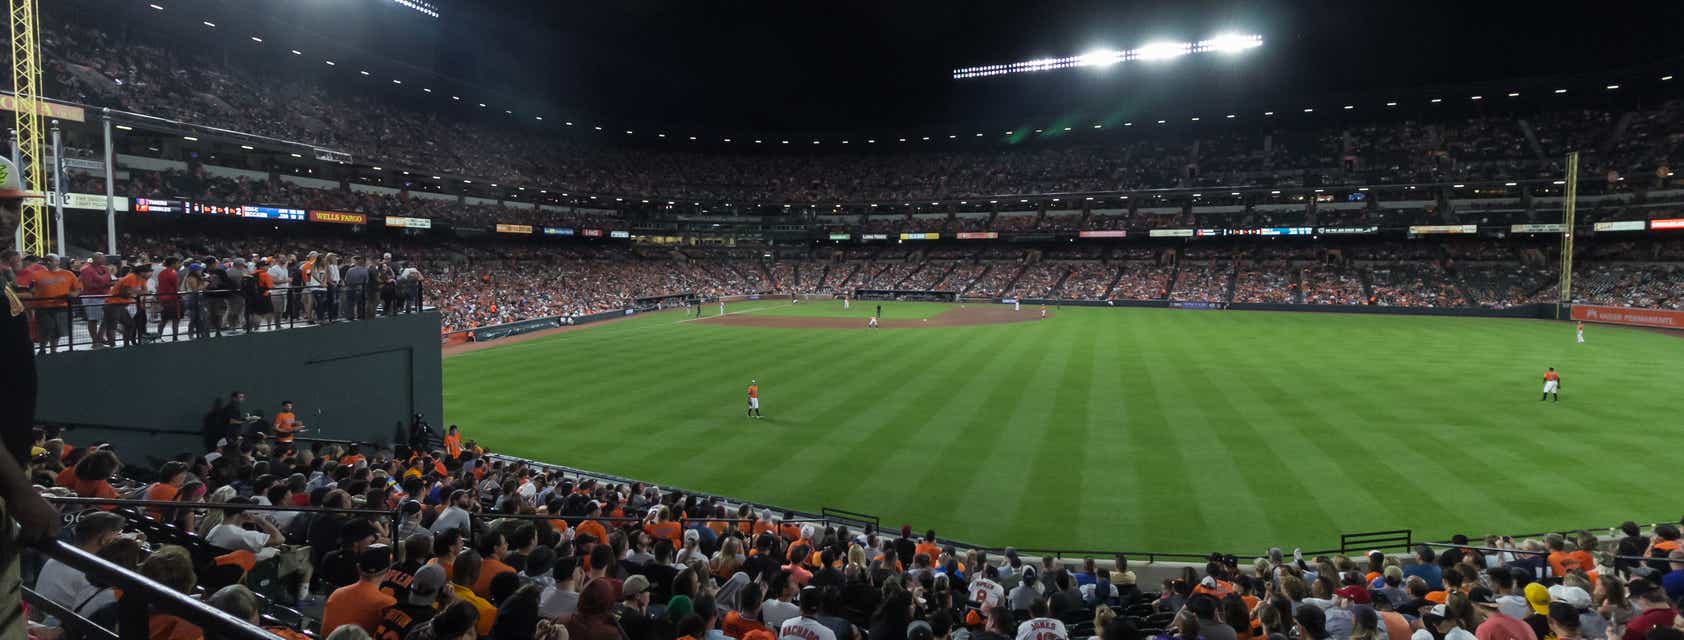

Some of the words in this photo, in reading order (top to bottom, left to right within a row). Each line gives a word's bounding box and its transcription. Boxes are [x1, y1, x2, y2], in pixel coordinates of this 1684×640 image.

[211, 206, 217, 214] 2
[316, 212, 339, 221] WELLS
[340, 214, 362, 222] FARGO
[1031, 622, 1056, 631] JONES
